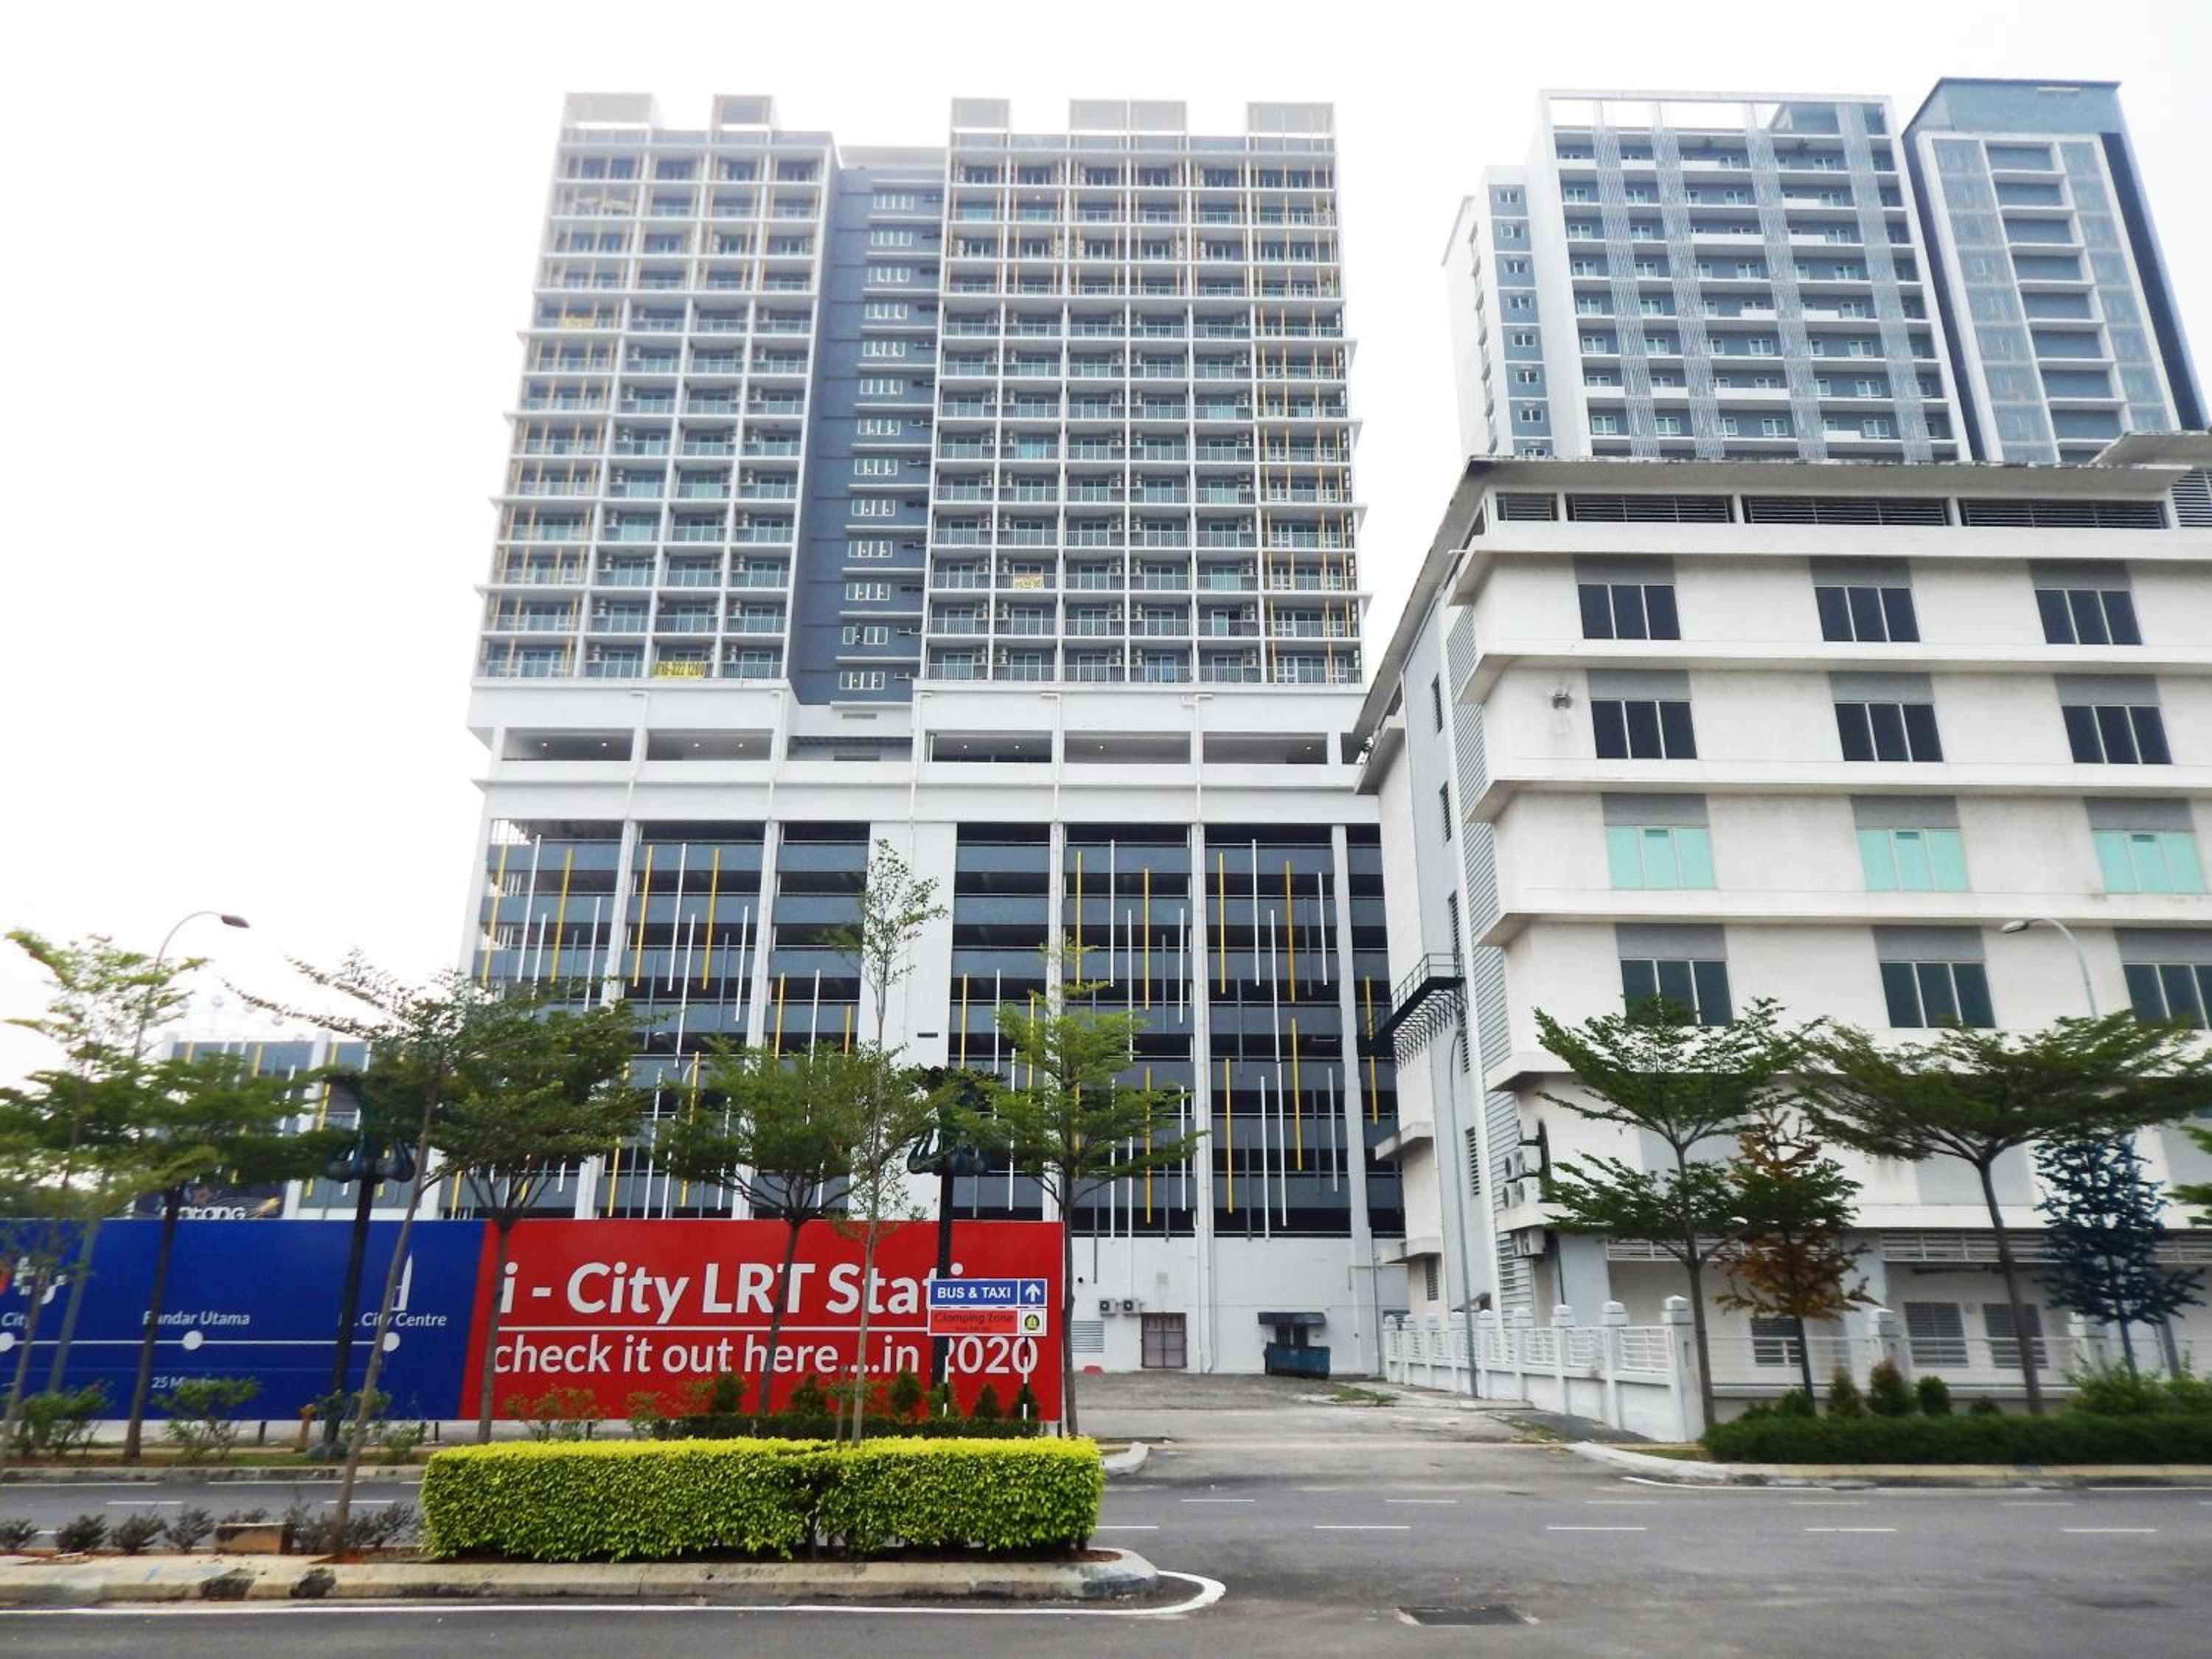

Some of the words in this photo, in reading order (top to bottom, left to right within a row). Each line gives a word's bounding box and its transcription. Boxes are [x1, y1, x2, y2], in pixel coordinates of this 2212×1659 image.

[500, 1262, 518, 1313] i
[532, 1287, 552, 1297] -
[567, 1262, 689, 1324] City
[702, 1263, 815, 1313] LRT
[937, 1287, 964, 1298] BUS
[968, 1287, 978, 1298] &
[981, 1287, 1011, 1298] TAXI
[142, 1310, 198, 1325] ndar
[199, 1310, 250, 1325] Utama
[396, 1312, 447, 1326] Centre
[495, 1334, 613, 1373] check
[623, 1334, 653, 1373] it
[663, 1338, 734, 1374] out
[151, 1376, 168, 1388] 25
